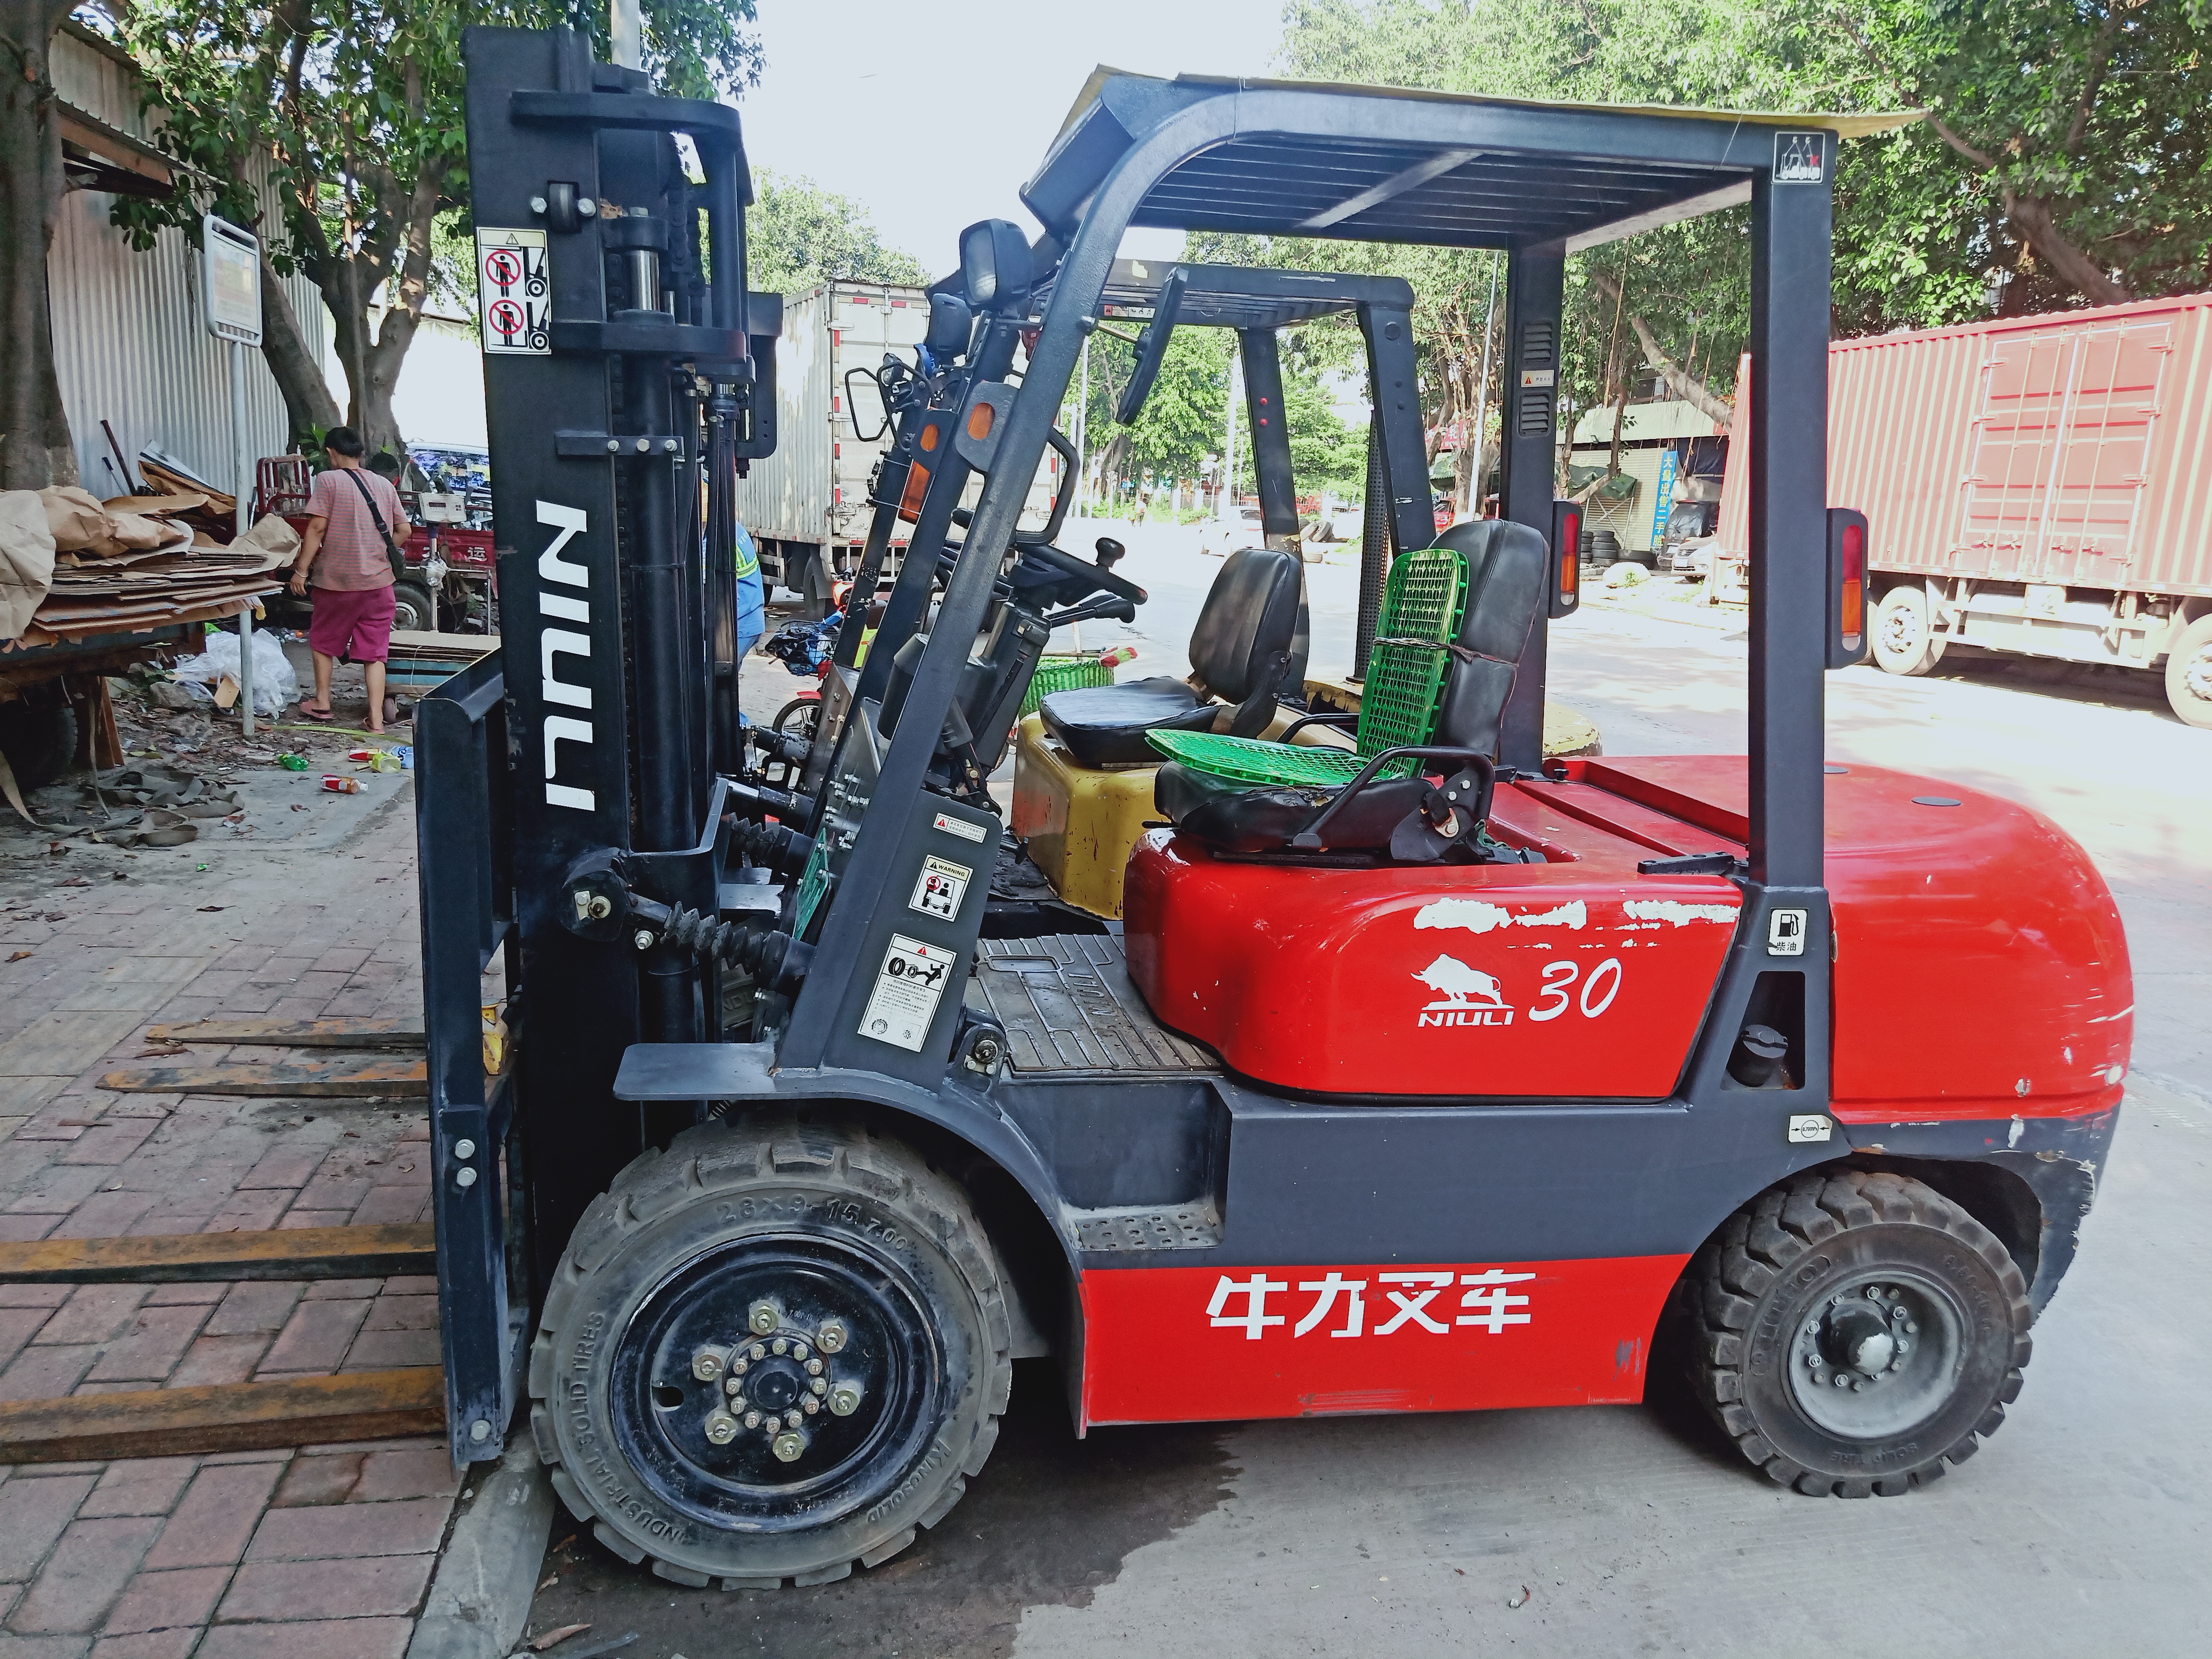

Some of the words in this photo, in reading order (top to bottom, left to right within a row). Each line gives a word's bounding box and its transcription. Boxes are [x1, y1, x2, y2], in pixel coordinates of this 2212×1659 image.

[1653, 456, 1673, 547] 大量出售二手胎
[536, 499, 595, 811] NIULI
[938, 865, 965, 877] WARNING
[1776, 941, 1796, 951] 柴油
[1417, 1010, 1515, 1027] NIULI
[1205, 1269, 1536, 1340] 牛力叉车
[572, 1311, 604, 1373] TIRES
[570, 1382, 596, 1452] SOLID
[585, 1448, 688, 1547] INDUSTRIAL
